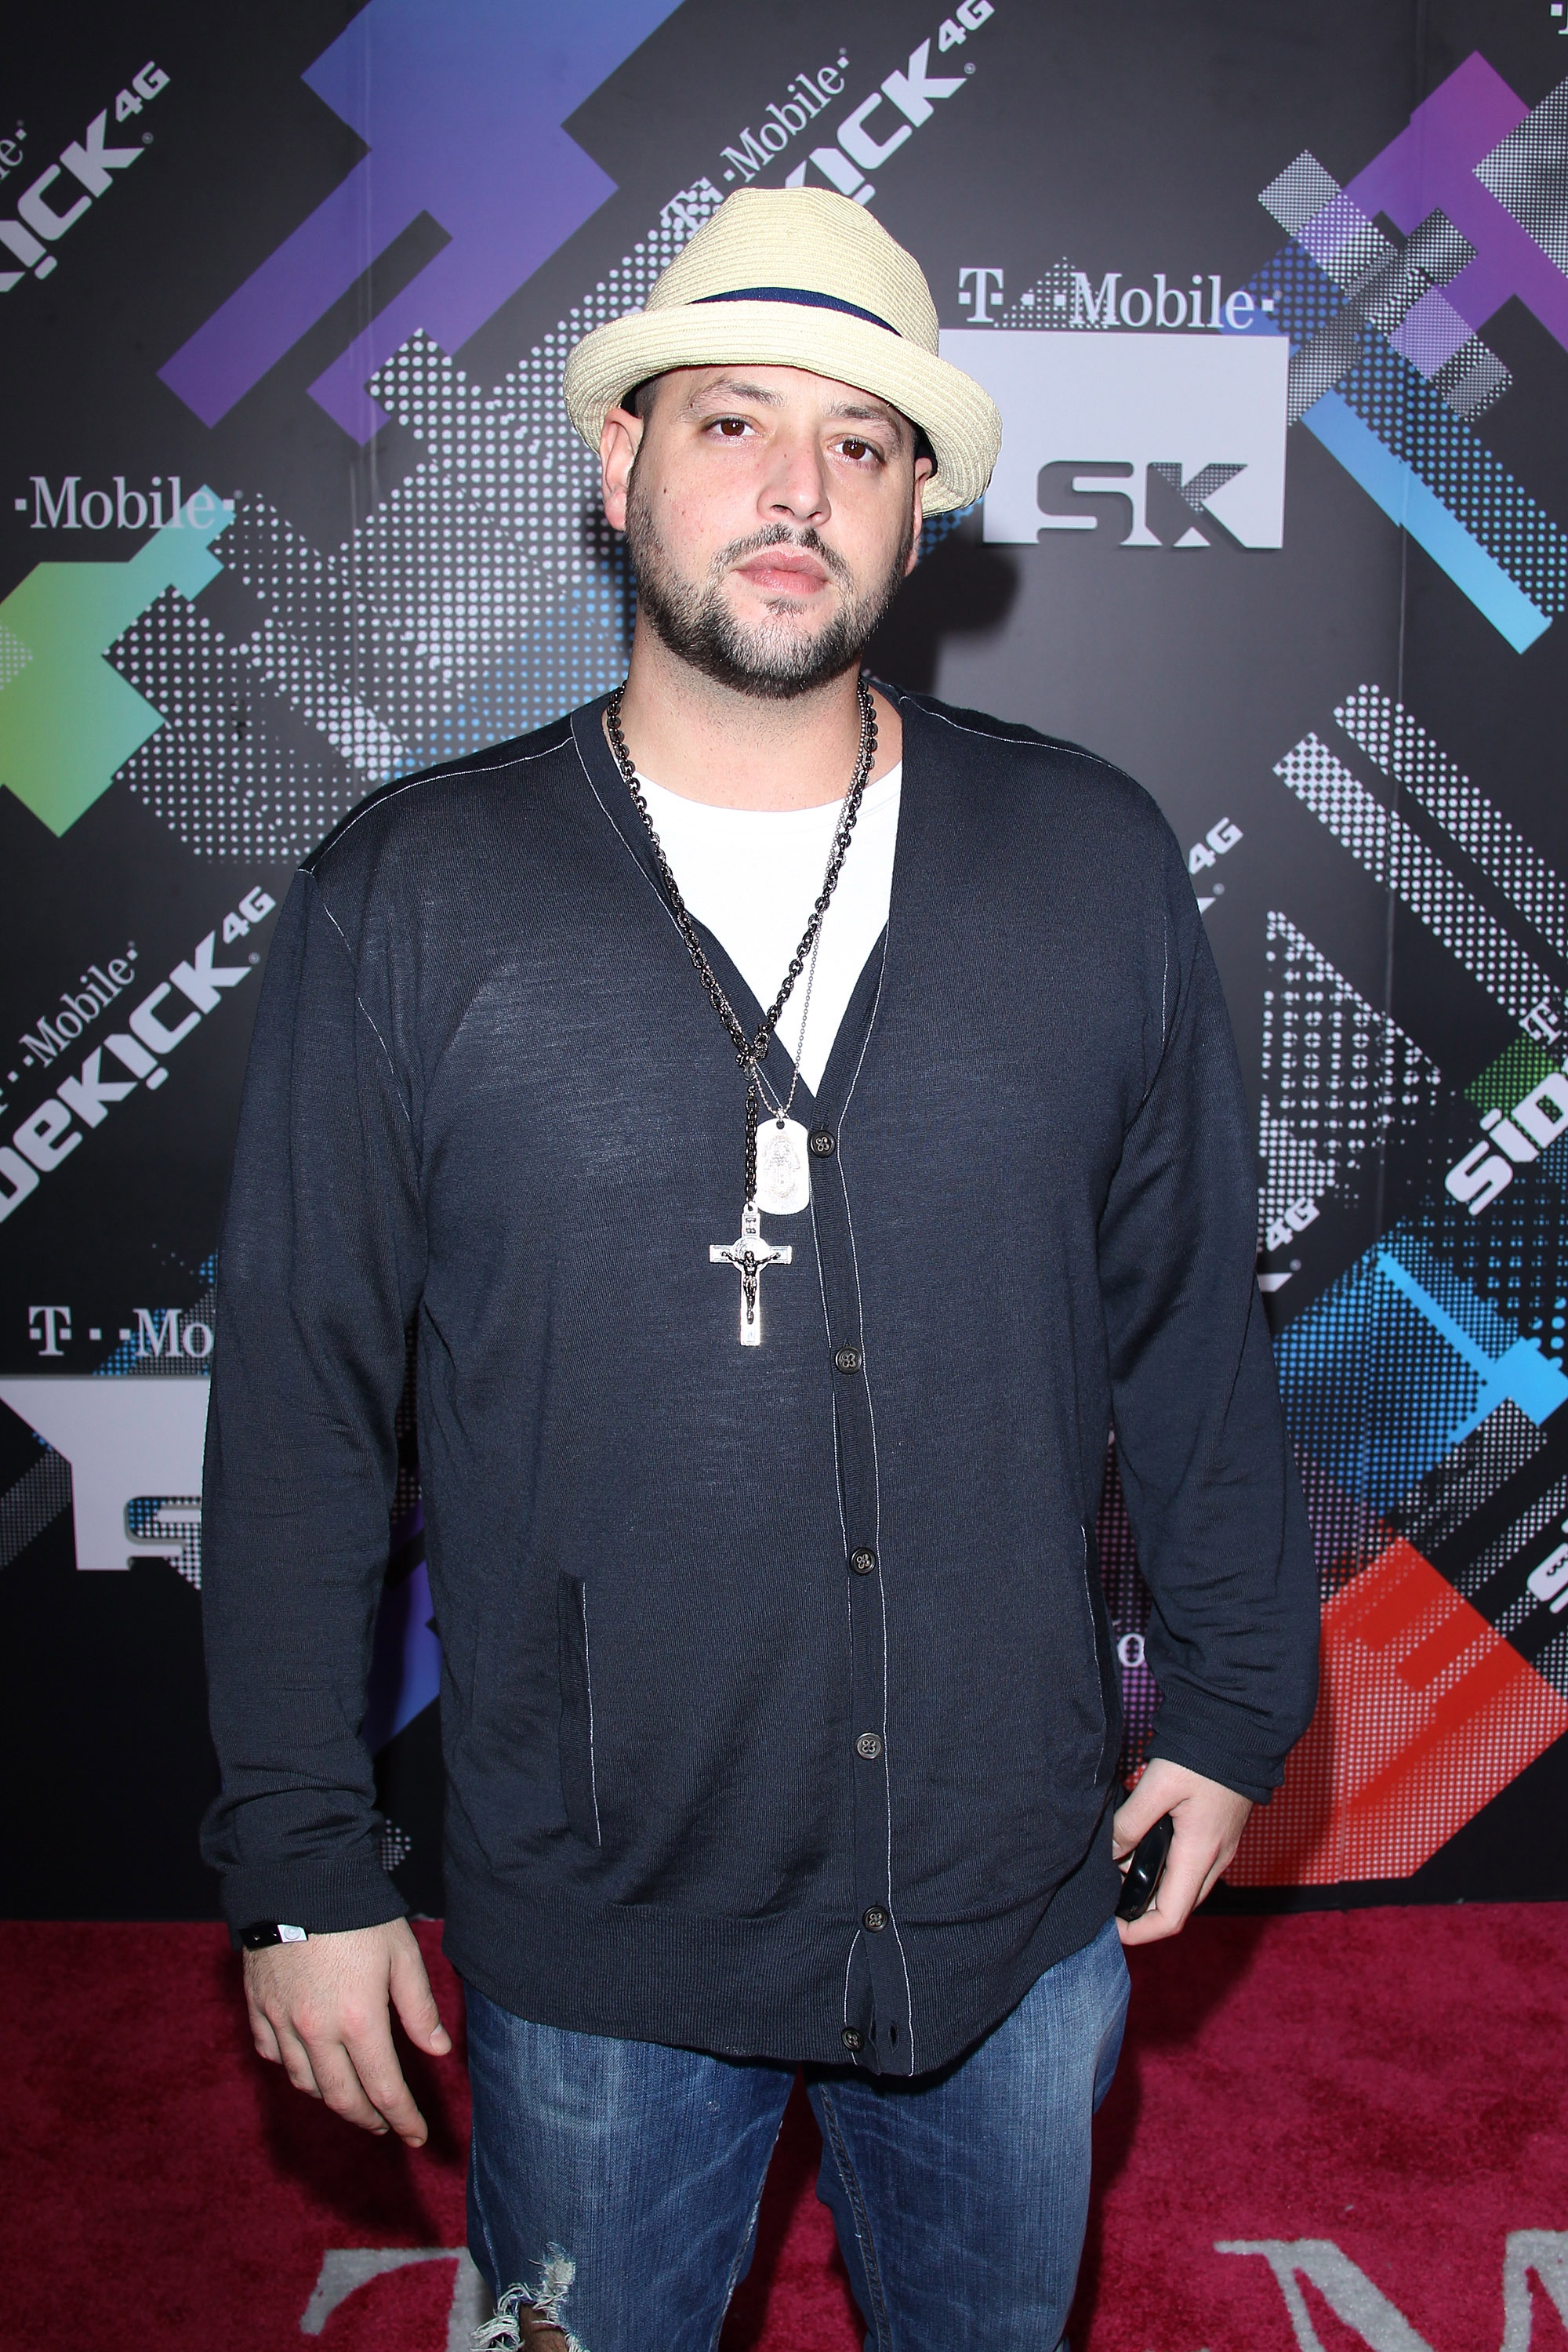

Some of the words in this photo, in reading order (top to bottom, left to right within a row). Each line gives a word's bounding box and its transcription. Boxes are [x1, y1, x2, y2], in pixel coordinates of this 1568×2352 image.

[938, 0, 995, 53] 4G
[115, 60, 170, 122] 4G
[720, 66, 845, 183] Mobile
[1069, 272, 1254, 329] Mobile
[28, 475, 216, 530] Mobile
[1188, 816, 1244, 876] 4G
[222, 886, 276, 944] 4G
[19, 957, 136, 1068] Mobile
[1265, 1196, 1321, 1252] 4G
